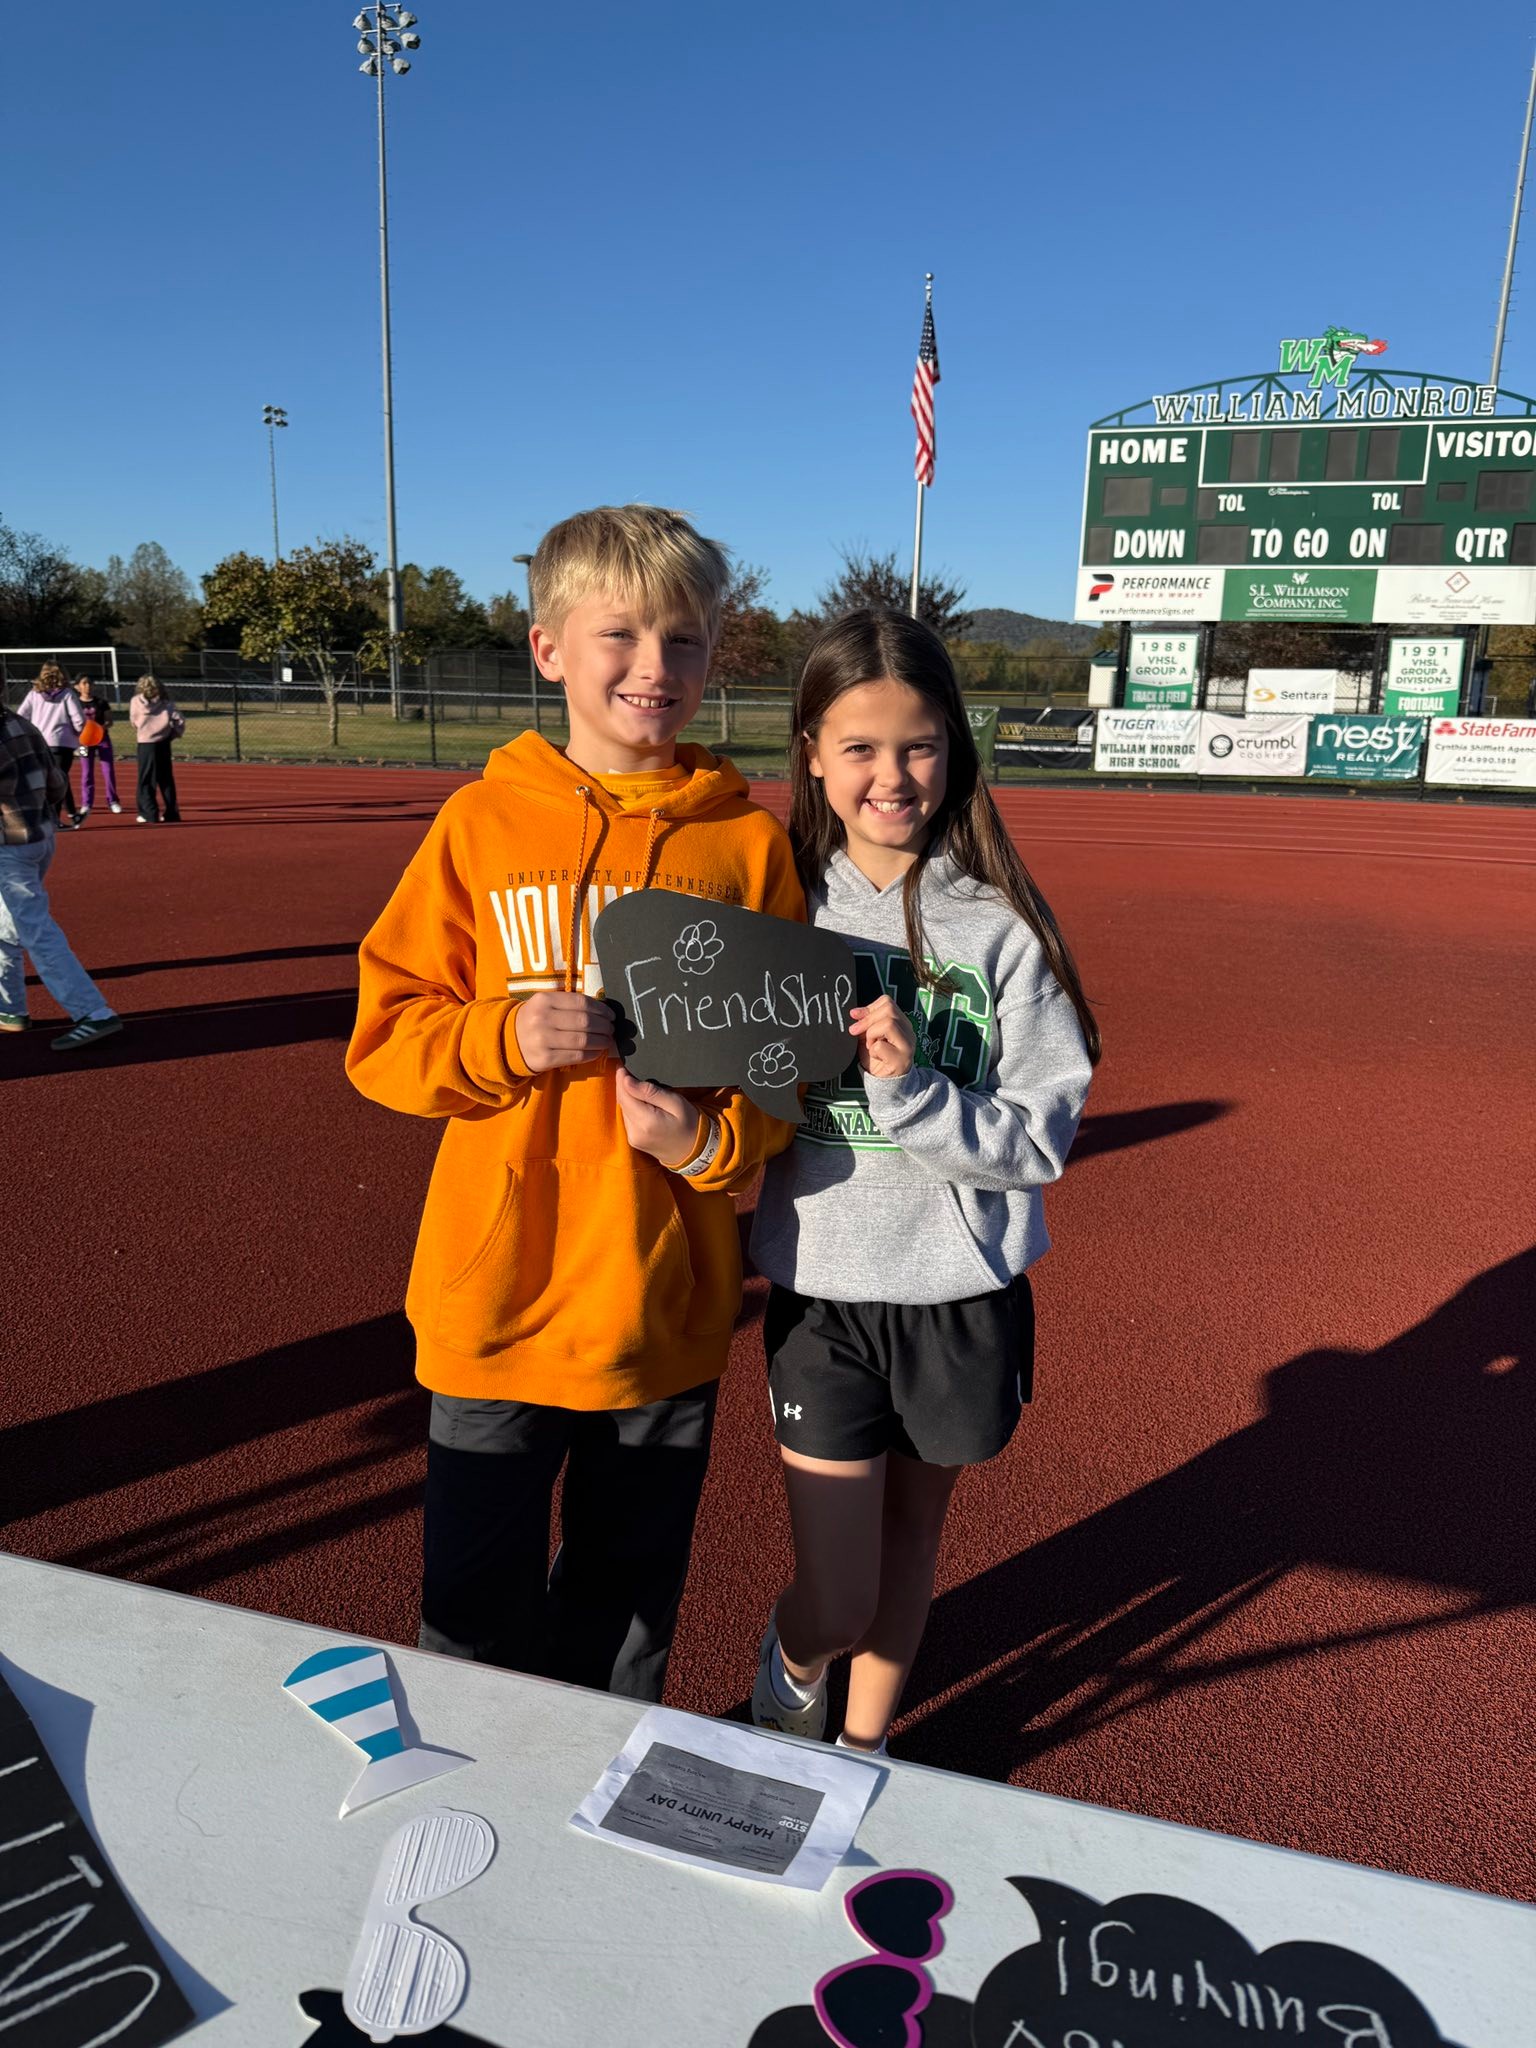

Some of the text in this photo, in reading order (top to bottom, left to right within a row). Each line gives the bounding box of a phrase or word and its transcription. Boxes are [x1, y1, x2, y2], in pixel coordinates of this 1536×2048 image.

[1152, 385, 1497, 424] WILLIAM MONROE
[1098, 437, 1188, 465] HOME
[1436, 430, 1536, 458] VISITO
[1218, 494, 1246, 512] TOL
[1372, 492, 1401, 510] TOL
[1113, 529, 1185, 559] DOWN
[1250, 528, 1387, 558] TO GO ON
[1455, 527, 1508, 563] QTR
[1122, 577, 1211, 589] PERFORMANCE
[1249, 584, 1350, 597] S.L. WILLIAMSON
[1100, 607, 1195, 616] www.PerformanceSigns.net
[1141, 642, 1186, 652] 1988
[1401, 646, 1448, 656] 1991
[1147, 656, 1178, 664] VHSL
[1135, 667, 1187, 675] GROUP A
[1280, 691, 1328, 700] Sentara
[1398, 696, 1444, 711] FOOTBALL
[1236, 736, 1297, 749] crumbl
[1316, 721, 1414, 750] nest
[1100, 743, 1146, 754] WILLIAM
[1150, 744, 1196, 755] MONROE
[1109, 757, 1180, 768] HIGH SCHOOL
[1336, 752, 1391, 763] REALTY
[624, 871, 642, 883] OF
[655, 872, 742, 900] TENNESSEE
[646, 1793, 679, 1810] DAY
[675, 1801, 723, 1824] UNITY
[722, 1814, 775, 1840] HAPPY
[778, 1819, 809, 1834] STOP
[1058, 1919, 1394, 2048] Bullying!
